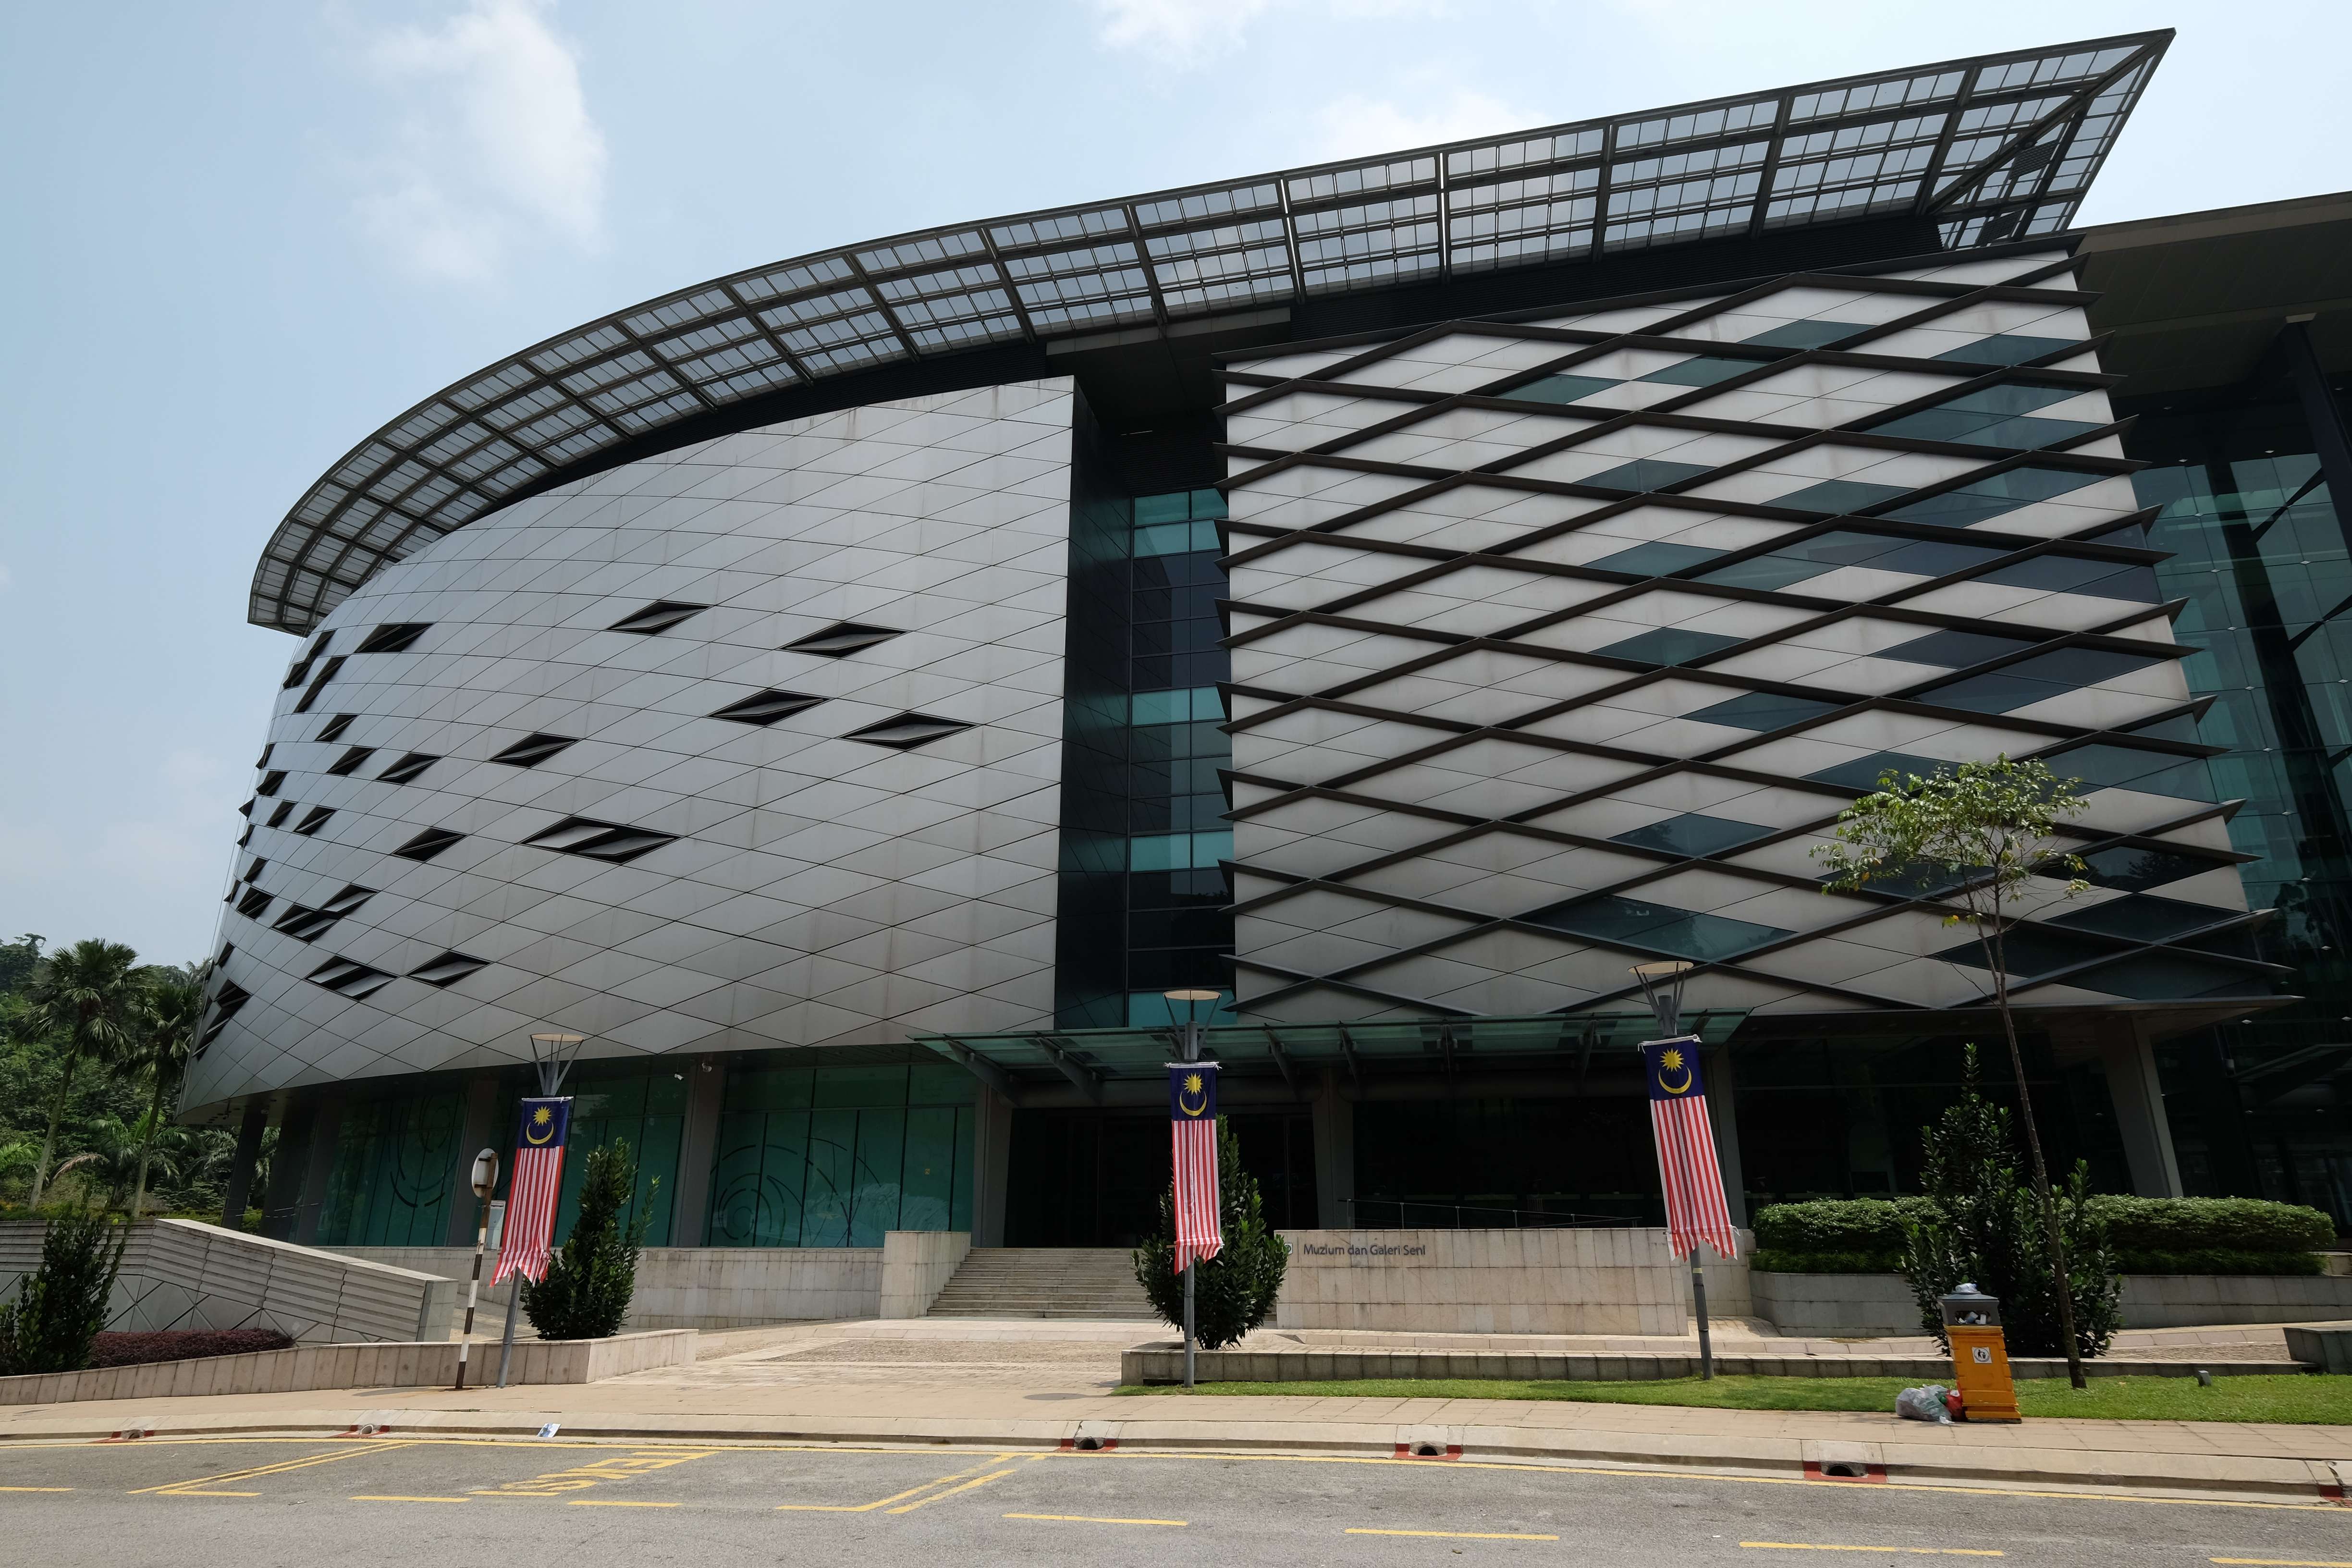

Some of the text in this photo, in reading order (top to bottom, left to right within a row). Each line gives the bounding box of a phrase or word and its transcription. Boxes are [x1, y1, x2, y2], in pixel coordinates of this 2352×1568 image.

[1304, 1244, 1426, 1255] Muzium dan Galeri Seni
[465, 1451, 723, 1496] TEKSI
